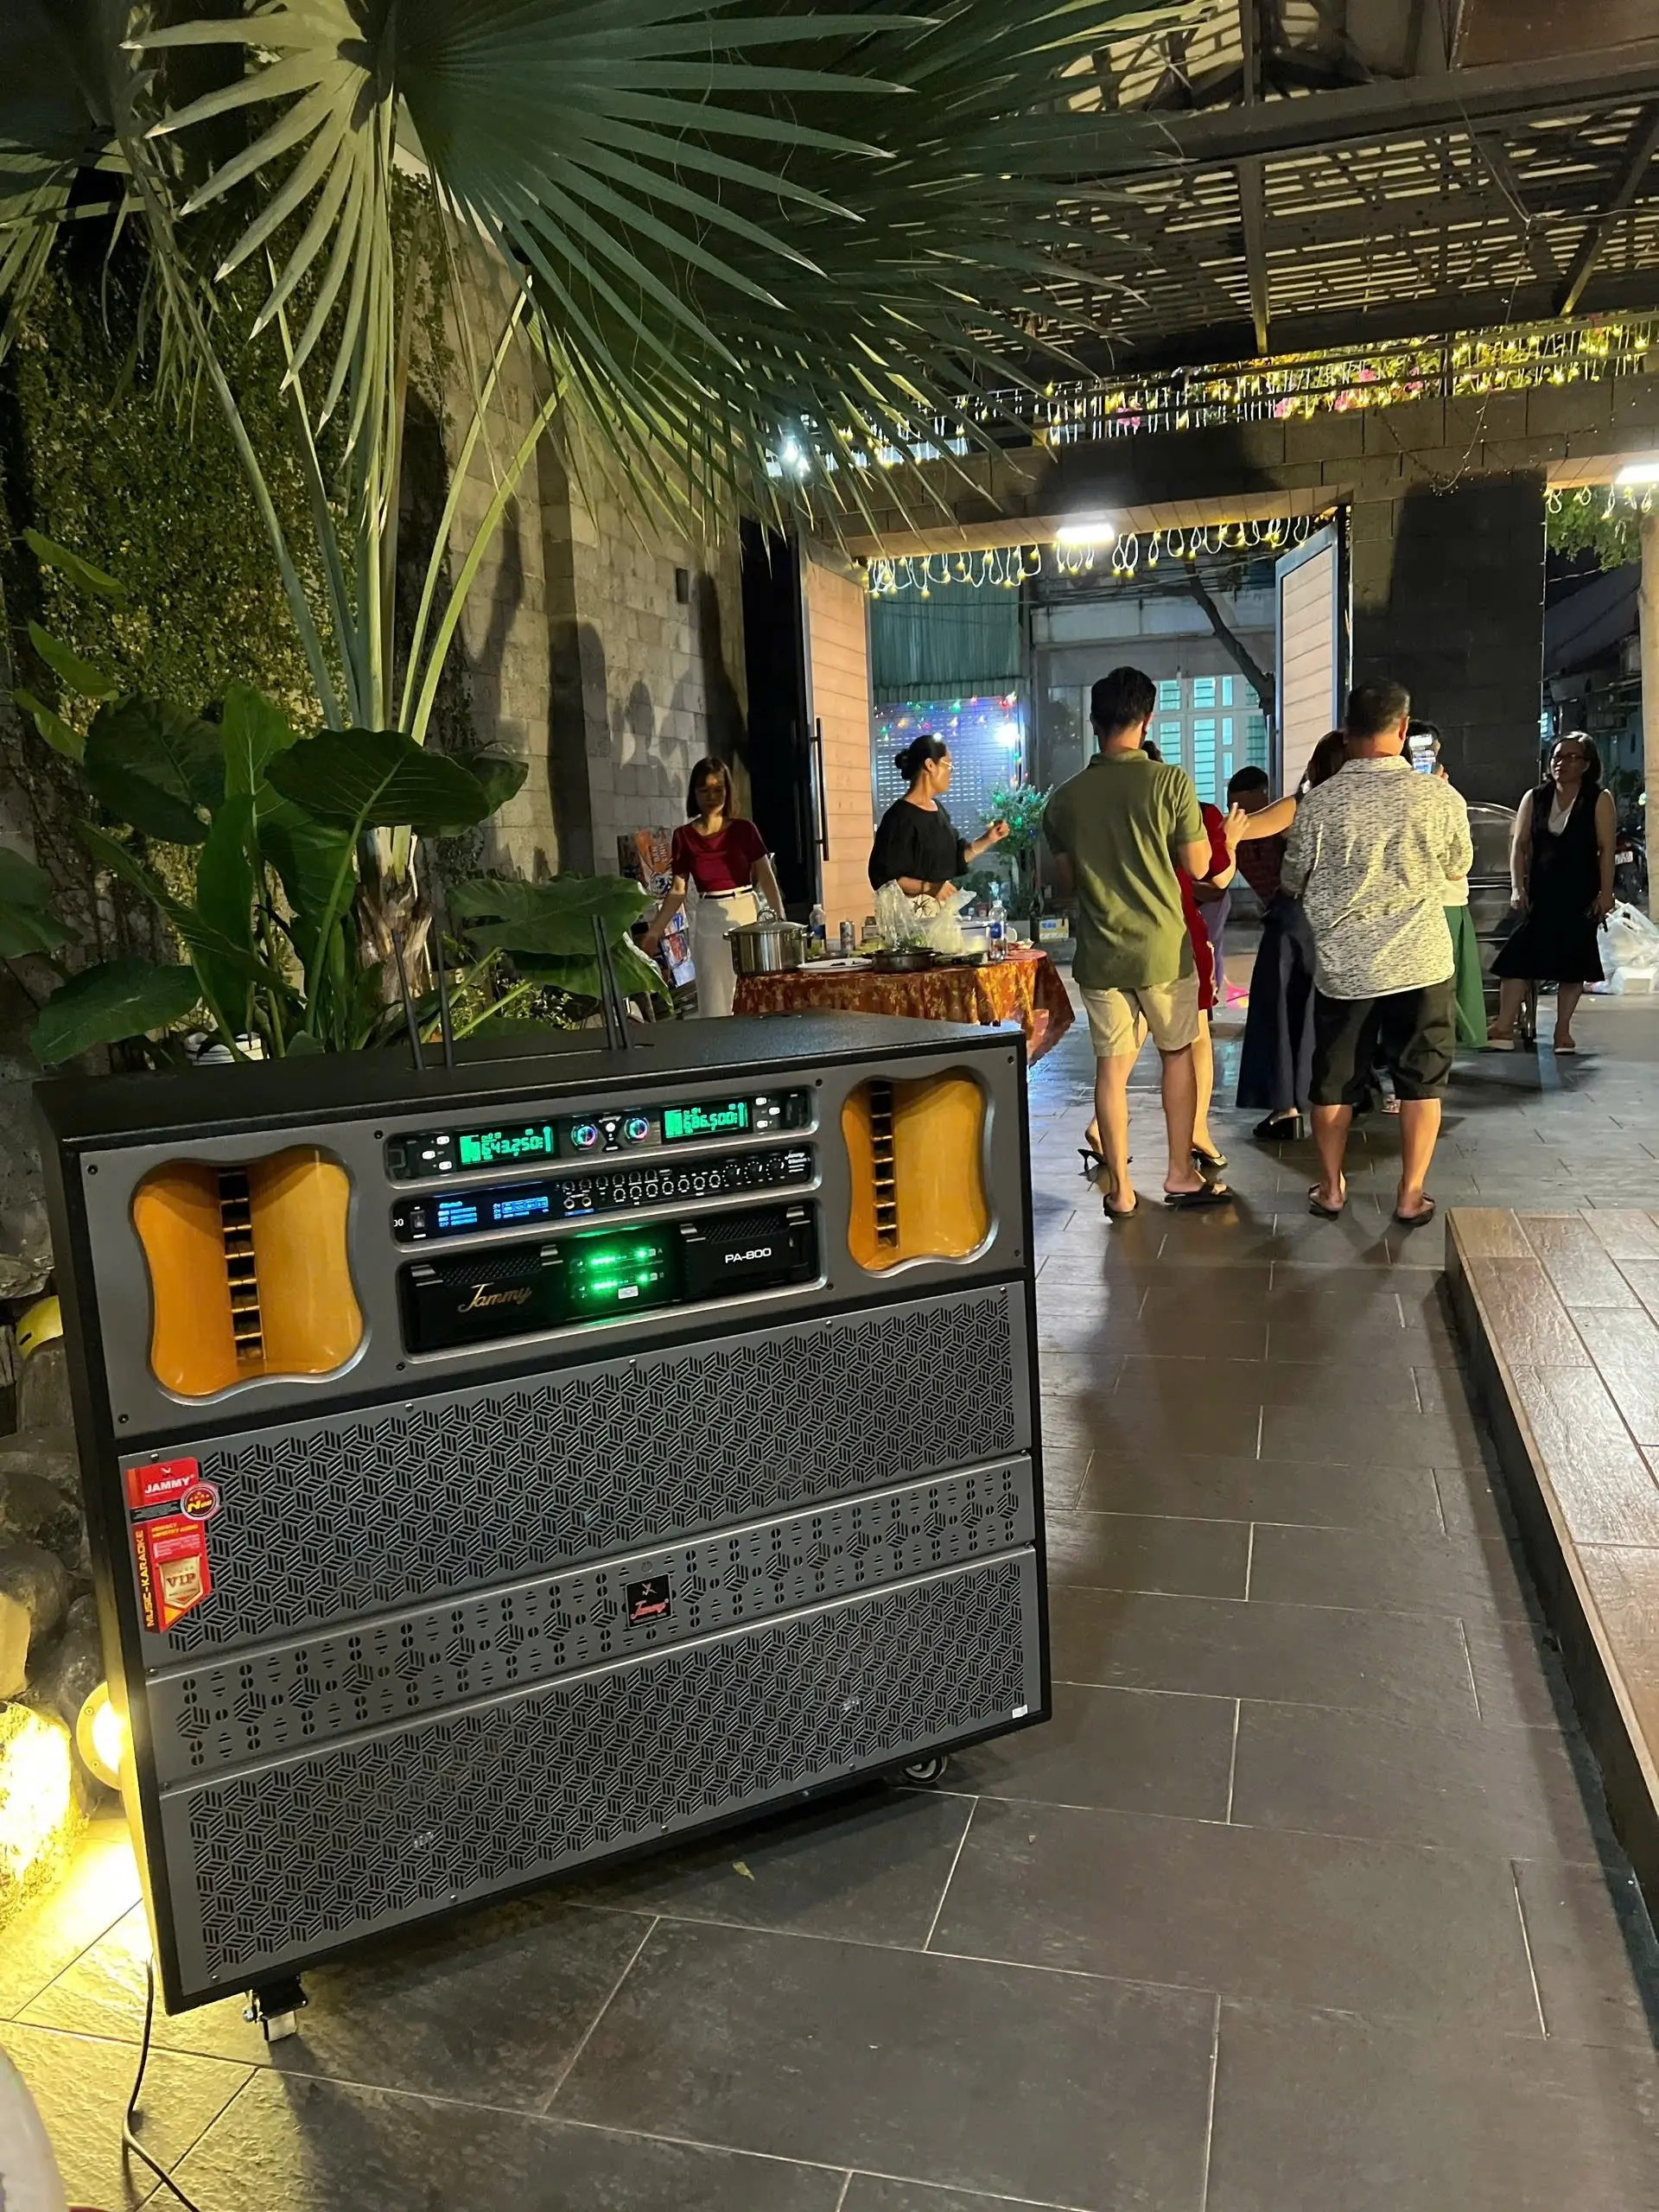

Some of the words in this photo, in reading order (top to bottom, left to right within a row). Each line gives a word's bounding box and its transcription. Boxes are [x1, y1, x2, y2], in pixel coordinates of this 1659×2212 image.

[725, 1248, 772, 1263] PA-800
[457, 1282, 532, 1313] Jammy
[144, 1476, 190, 1494] JAMMY
[166, 1573, 196, 1587] VIP
